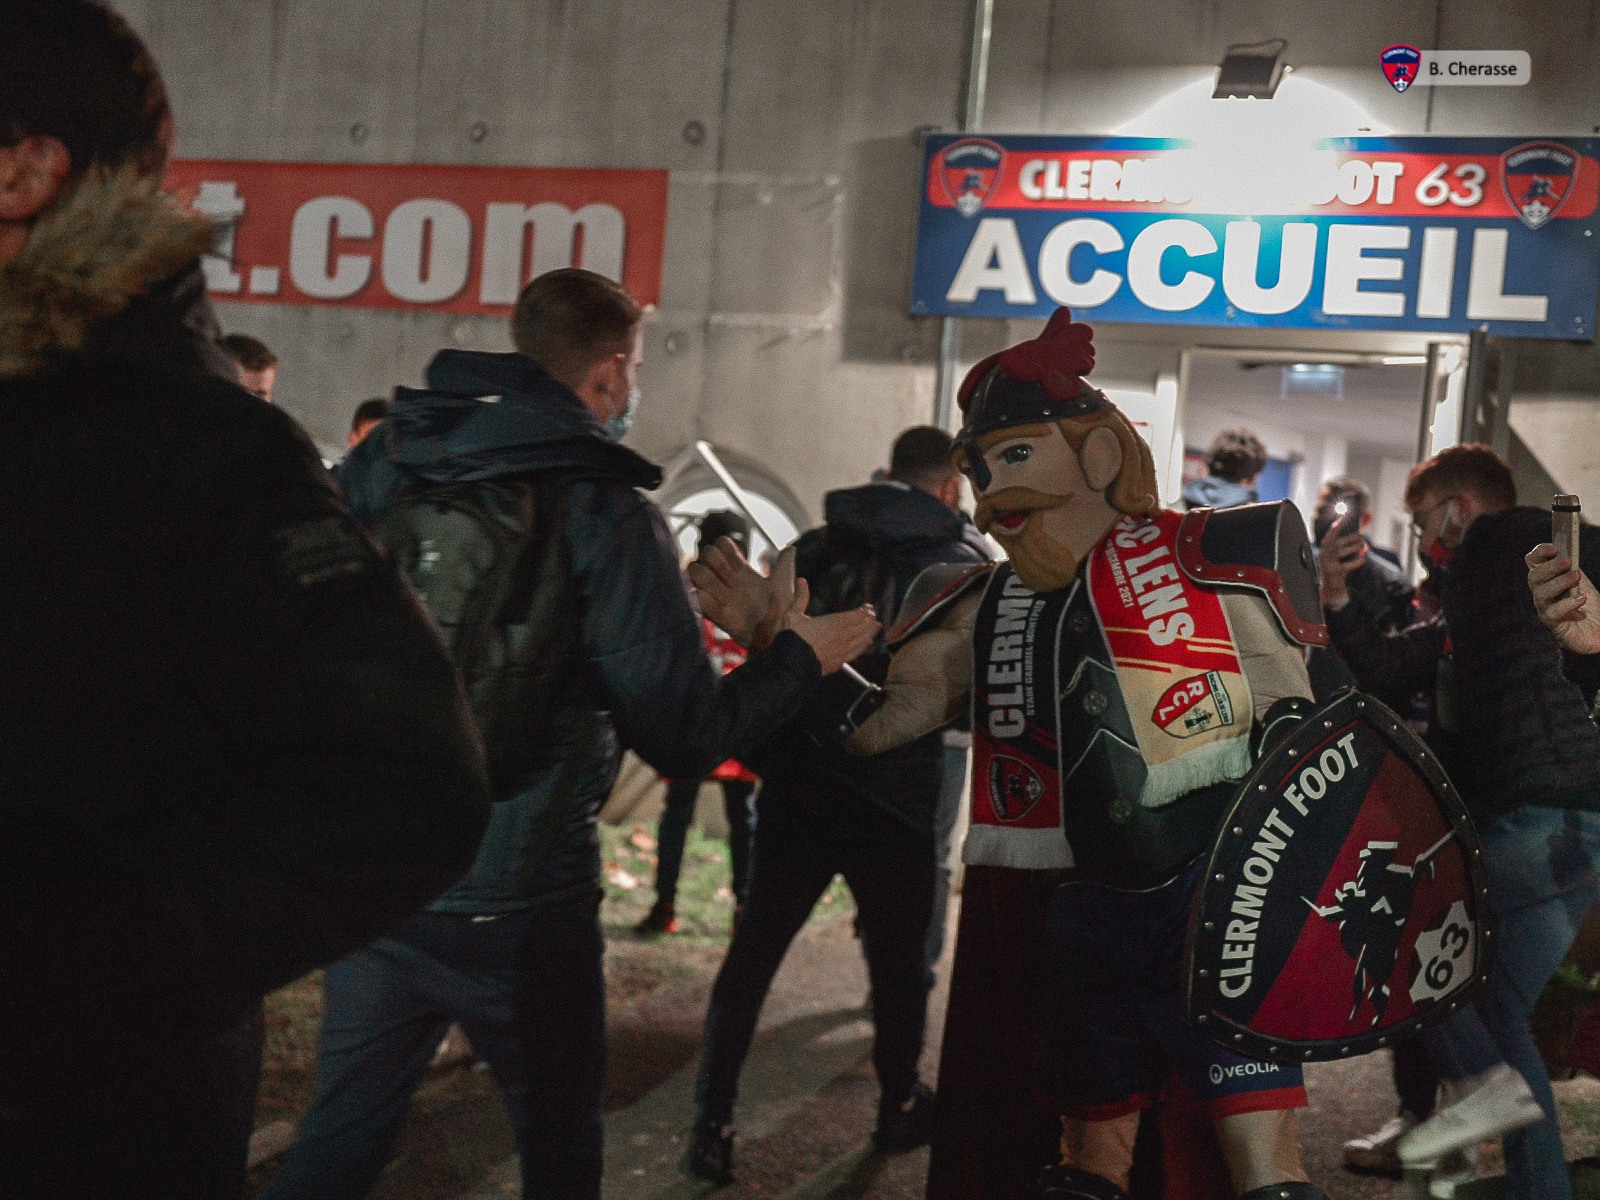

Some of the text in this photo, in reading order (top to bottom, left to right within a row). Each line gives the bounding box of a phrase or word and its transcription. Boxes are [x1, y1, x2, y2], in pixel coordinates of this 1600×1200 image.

[1414, 163, 1487, 207] 63
[945, 217, 1549, 321] ACCUEIL
[1119, 586, 1134, 608] 2021
[1124, 545, 1195, 646] LENS
[1218, 732, 1360, 998] CLERMONT FOOT
[1425, 922, 1470, 990] 63
[1224, 1061, 1280, 1078] VEOLIA
